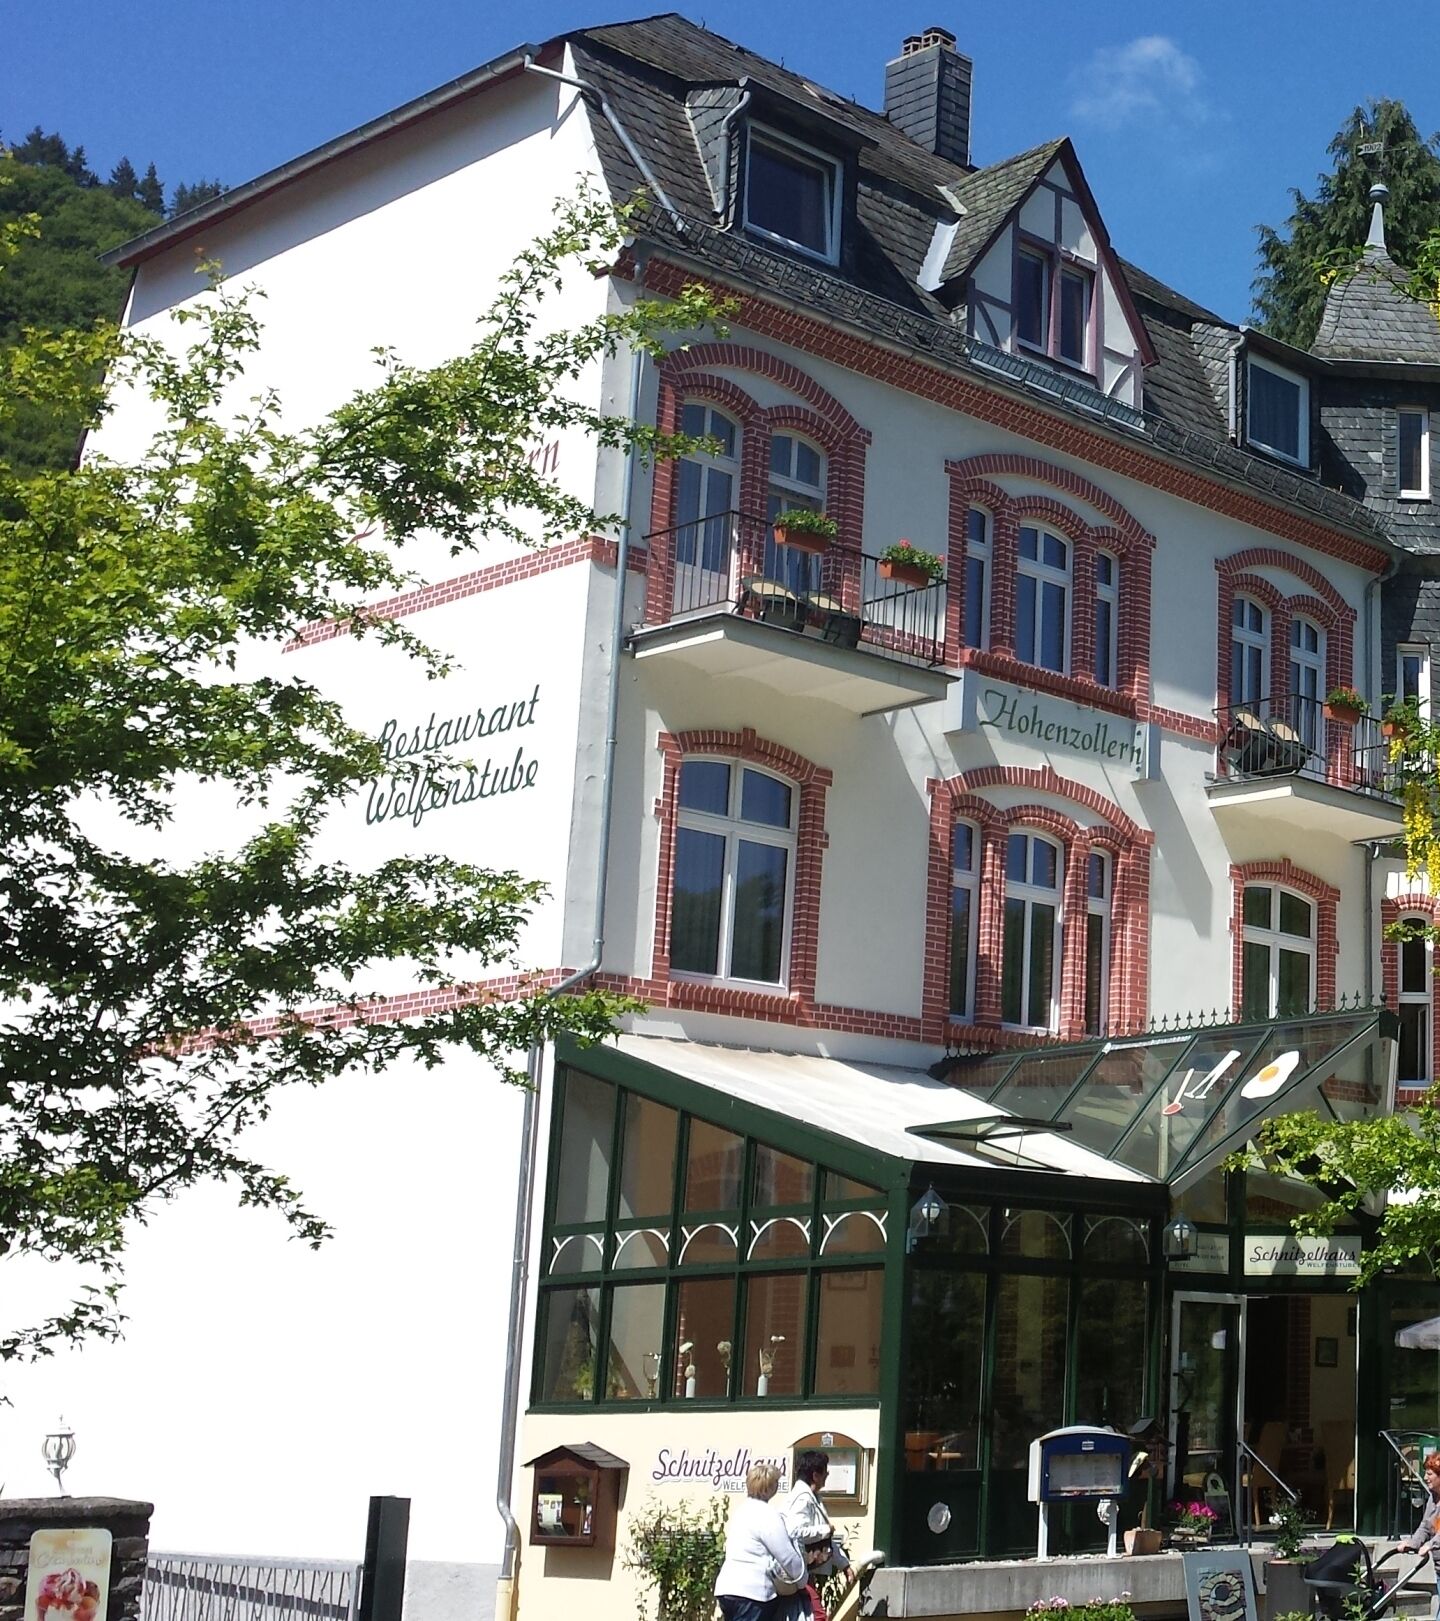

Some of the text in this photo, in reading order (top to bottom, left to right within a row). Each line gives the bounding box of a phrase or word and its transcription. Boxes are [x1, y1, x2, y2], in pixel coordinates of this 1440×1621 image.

[378, 684, 540, 761] Restaurant
[979, 689, 1143, 765] Hohenzollern
[366, 746, 539, 828] Welfenstube
[1250, 1246, 1356, 1265] Schnitzelhaus
